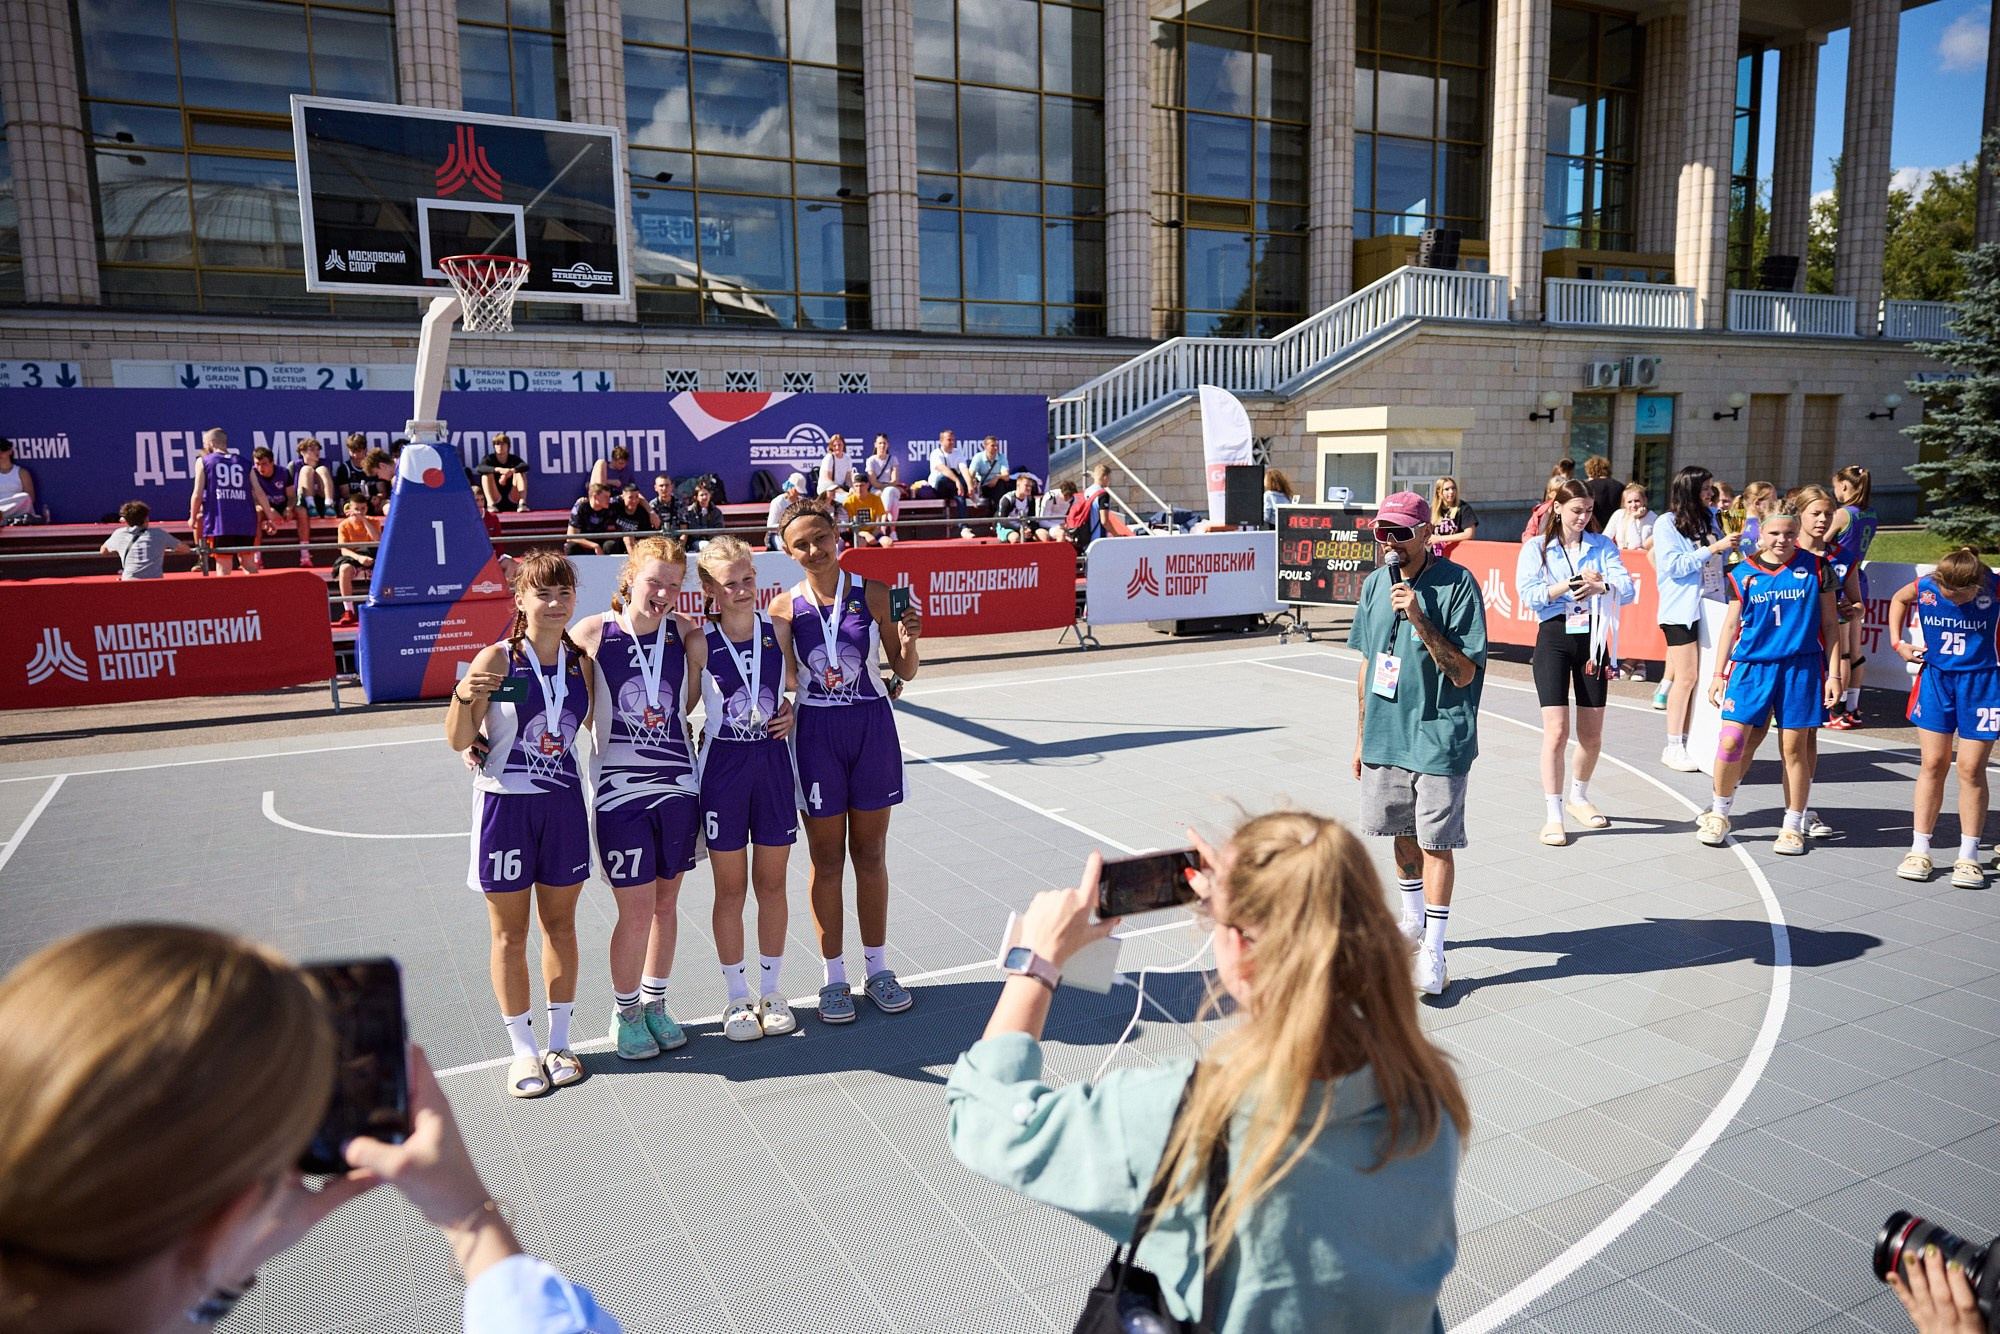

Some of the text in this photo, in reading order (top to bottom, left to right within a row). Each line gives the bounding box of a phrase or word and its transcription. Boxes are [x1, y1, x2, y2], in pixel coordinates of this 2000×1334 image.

[348, 250, 406, 264] МОСКОВСКИЙ
[349, 261, 376, 273] СПОРТ
[552, 271, 613, 282] STREETBASKET
[21, 363, 43, 388] 3
[201, 365, 241, 374] ТРИБУНА
[205, 374, 239, 383] GRADIN
[243, 366, 268, 389] D
[271, 375, 307, 383] SECTEUR
[273, 367, 305, 375] СЕКТОР
[316, 367, 335, 390] 2
[509, 370, 529, 392] D
[572, 371, 583, 392] 1
[216, 463, 244, 488] 96
[431, 520, 446, 565] 1
[1330, 530, 1359, 542] TIME
[1166, 547, 1255, 575] МОСКОВСКИЙ
[1326, 560, 1361, 571] SHOT
[930, 562, 1039, 592] МОСКОВСКИЙ
[1165, 575, 1208, 596] СПОРТ
[1278, 570, 1312, 581] FOULS
[930, 593, 982, 617] СПОРТ
[1750, 588, 1805, 605] МЫТИЩИ
[418, 619, 466, 628] SPORT.MOS.RU
[1772, 604, 1781, 626] 1
[1923, 615, 1987, 631] МЫТИЩИ
[94, 610, 262, 651] МОСКОВСКИЙ
[413, 632, 473, 641] STREETBASKET.RU
[415, 643, 487, 654] STREETBASKETRUSSIA
[1940, 631, 1966, 656] 25
[98, 650, 178, 681] СПОРТ
[627, 644, 657, 668] 27
[1976, 707, 2000, 732] 25
[808, 782, 823, 810] 4
[705, 811, 719, 840] 6
[489, 849, 522, 881] 16
[607, 848, 643, 879] 27
